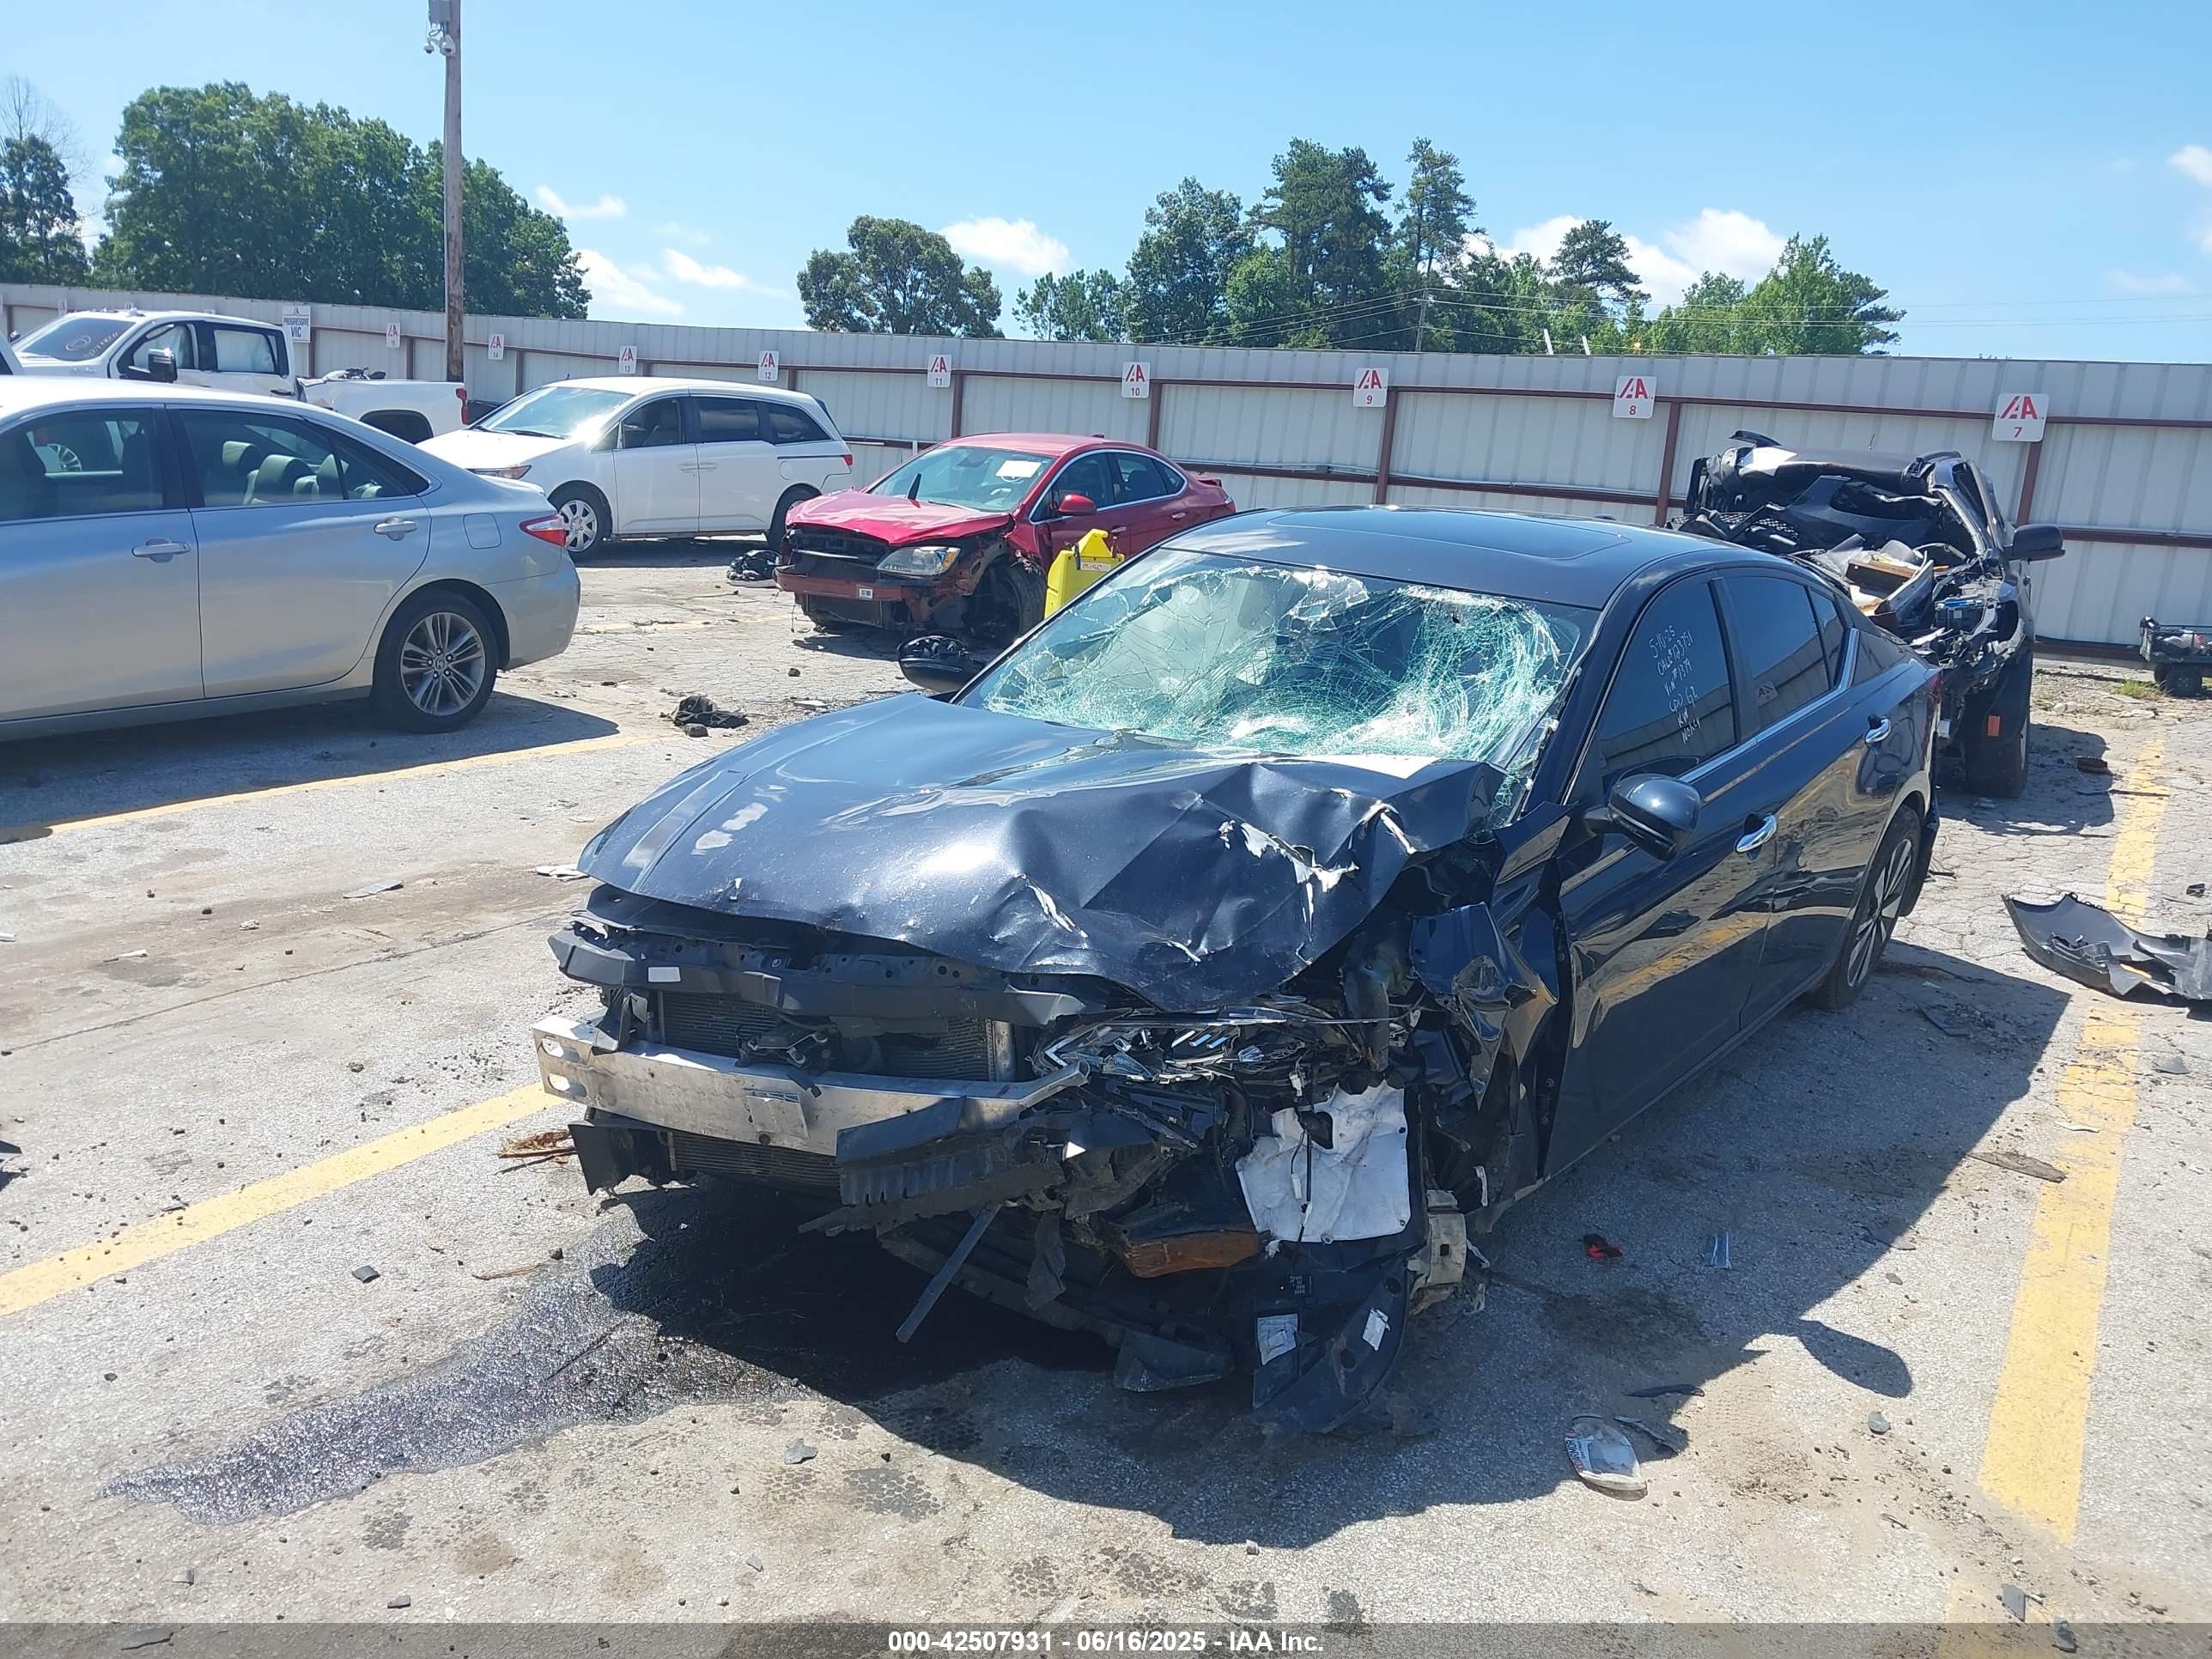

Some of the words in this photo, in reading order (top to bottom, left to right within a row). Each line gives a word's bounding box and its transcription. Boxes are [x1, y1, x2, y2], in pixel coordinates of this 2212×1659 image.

[291, 326, 301, 337] VIC
[1131, 387, 1140, 396] 10
[1366, 395, 1373, 404] 9
[1629, 405, 1637, 415] 8
[2014, 427, 2022, 438] 7
